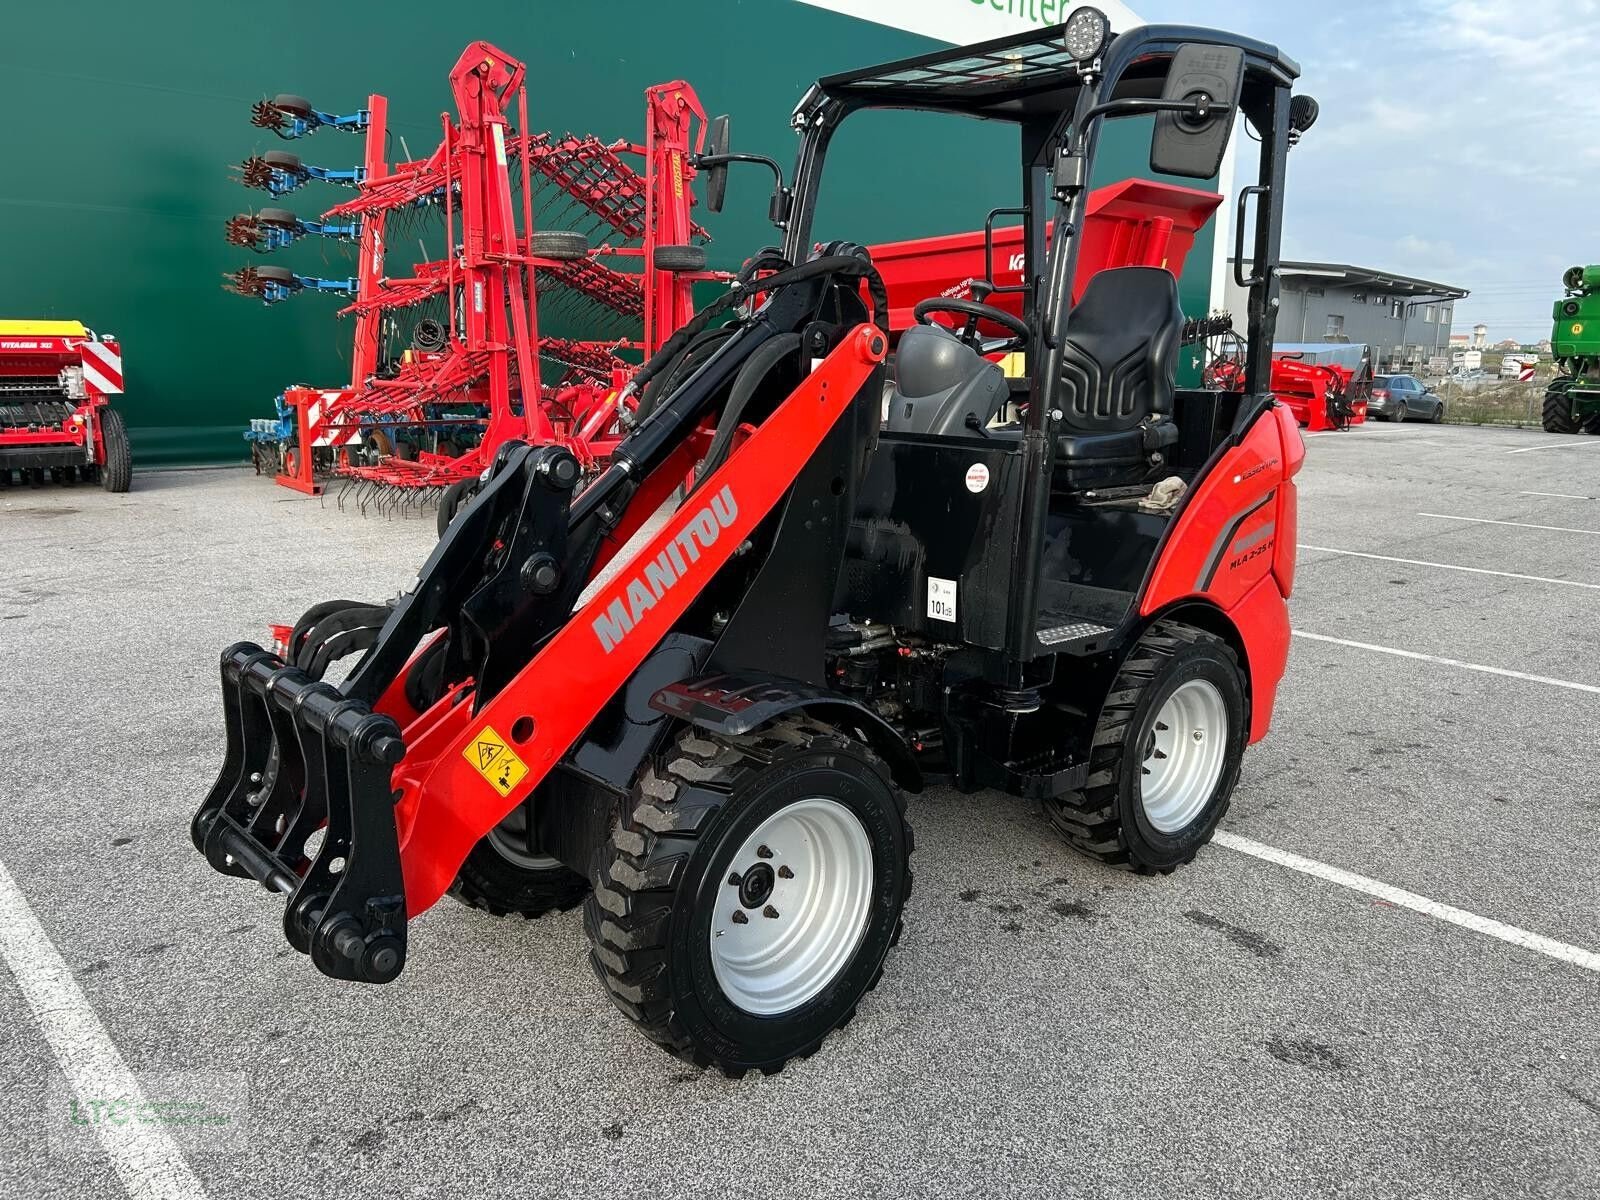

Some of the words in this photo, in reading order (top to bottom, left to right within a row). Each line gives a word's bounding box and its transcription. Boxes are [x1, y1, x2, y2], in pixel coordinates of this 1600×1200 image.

[672, 152, 683, 199] AEROSTAR
[592, 484, 738, 655] MANITOU
[1229, 554, 1248, 571] MLA
